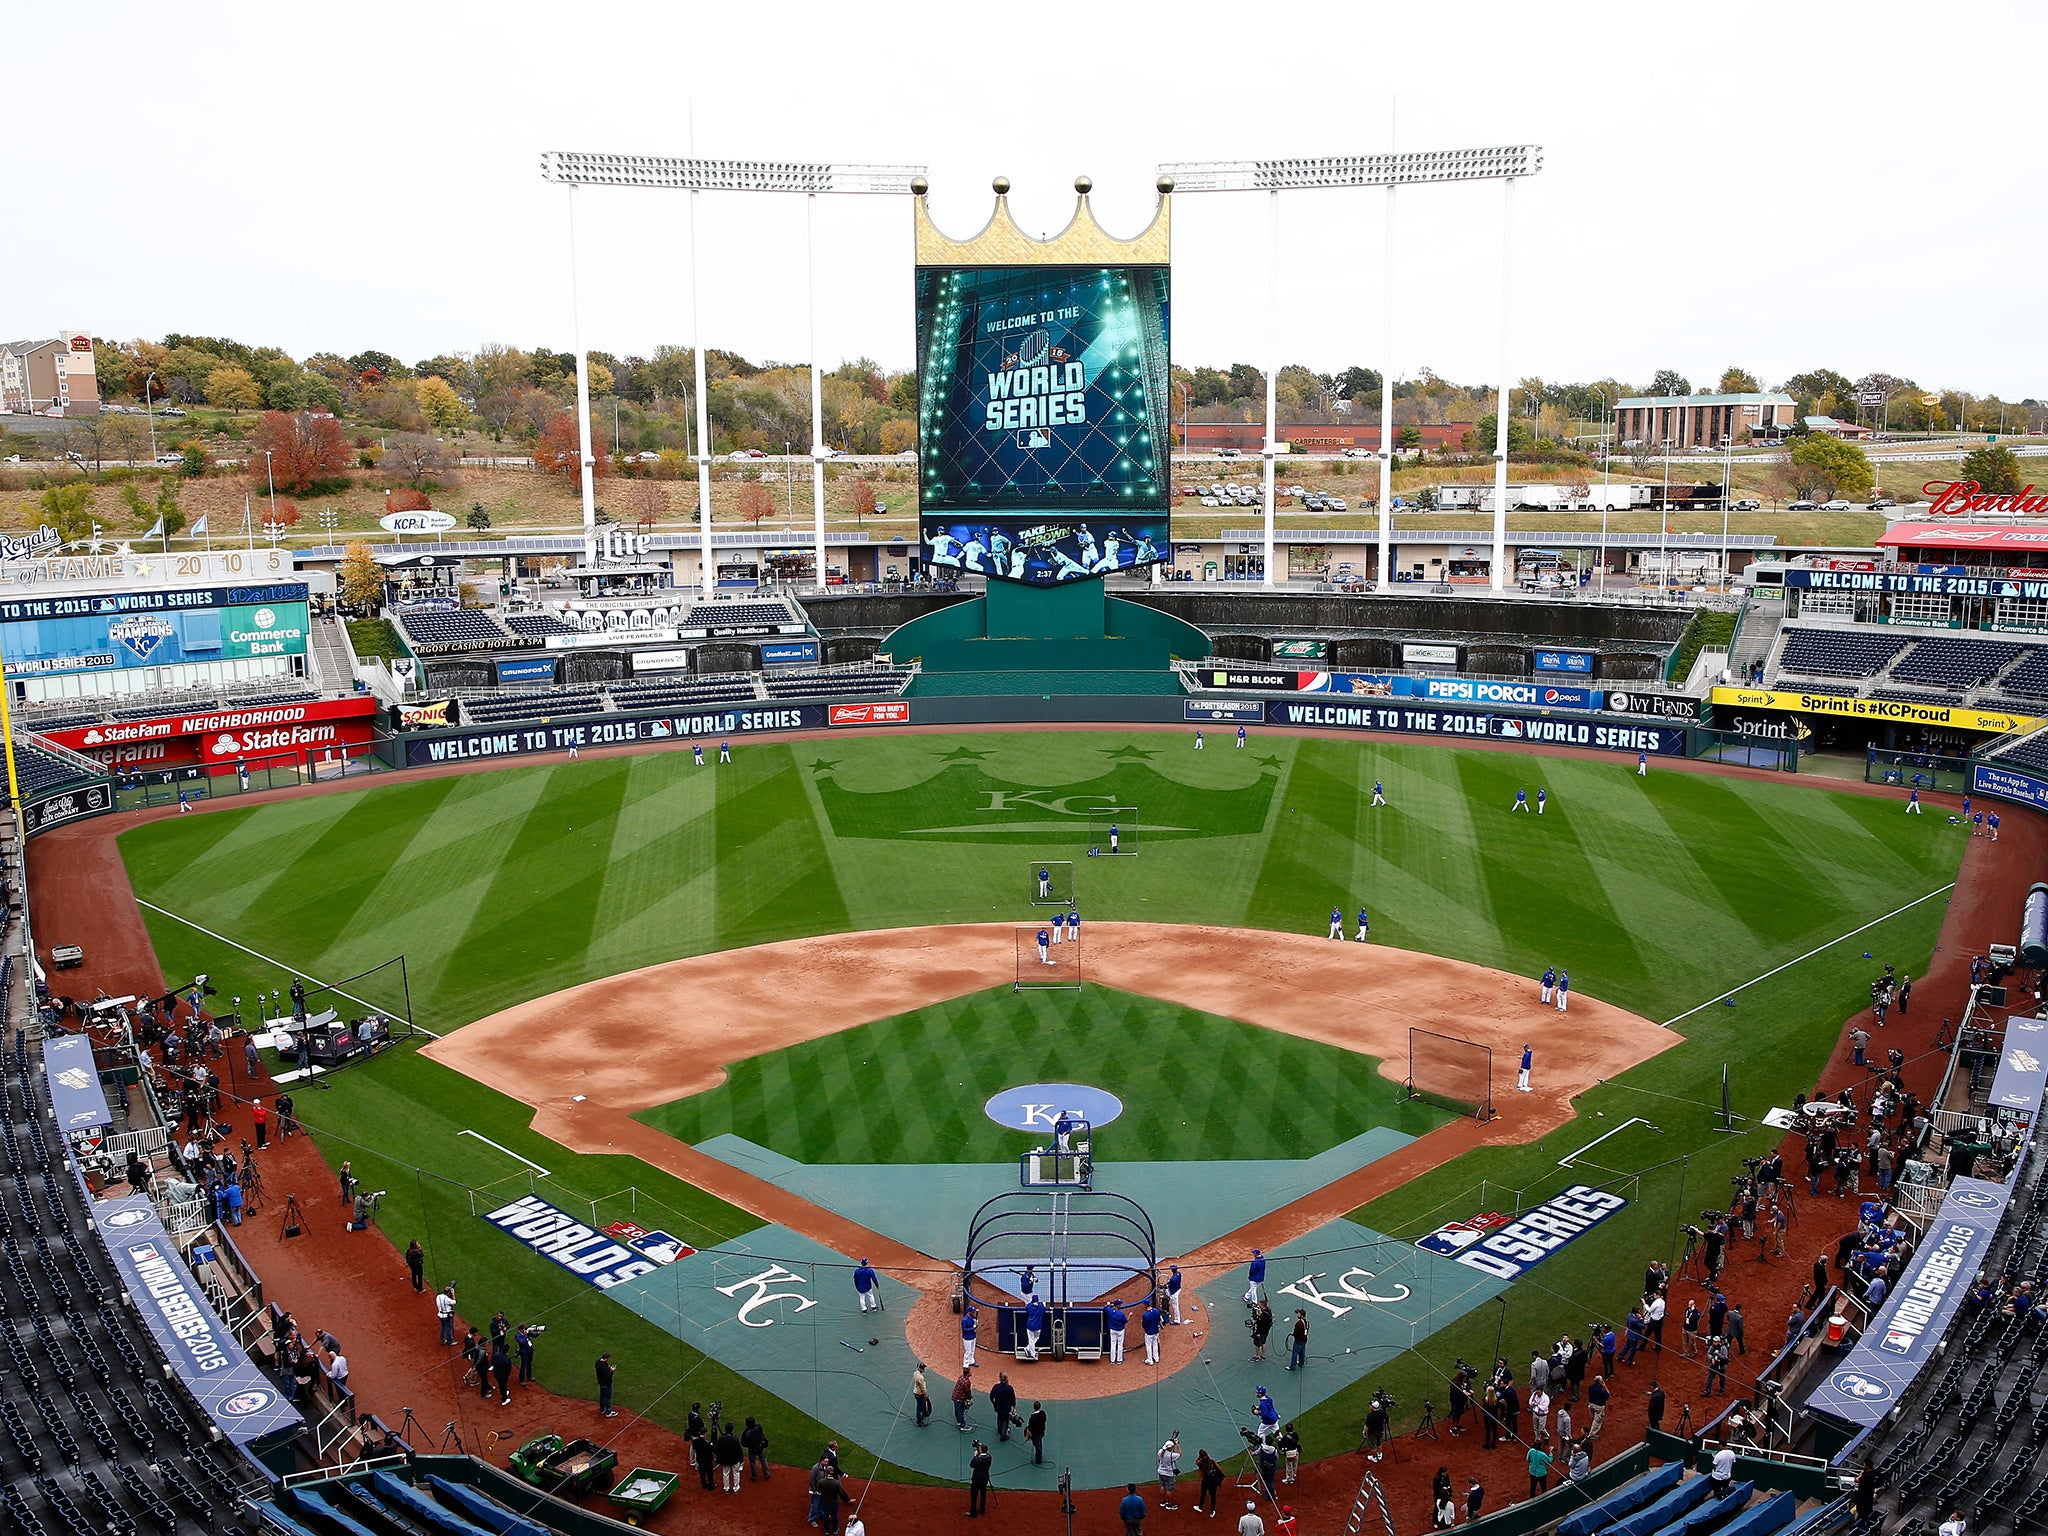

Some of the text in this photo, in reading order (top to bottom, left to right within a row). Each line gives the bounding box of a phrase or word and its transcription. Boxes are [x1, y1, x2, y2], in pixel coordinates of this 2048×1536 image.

[987, 306, 1080, 333] WELCOME TO THE
[1005, 355, 1018, 363] 20
[988, 362, 1085, 400] WORLD
[985, 392, 1086, 430] SERIES
[394, 518, 426, 530] KCP&L
[1018, 525, 1047, 540] TAKE
[0, 524, 62, 562] Royals
[600, 531, 651, 563] Lite
[19, 555, 126, 588] of FAME
[176, 551, 282, 577] 20 10 5
[1036, 570, 1052, 578] 2:37
[1809, 572, 1883, 590] WELCOME
[1888, 576, 1909, 591] TO
[1913, 577, 1943, 593] THE
[1946, 579, 1988, 595] 2015
[2, 591, 213, 618] TO THE 2015 WORLD SERIES
[600, 601, 633, 609] ORIGINAL
[608, 615, 626, 627] Lite
[632, 614, 650, 627] Lite
[654, 613, 668, 626] Lite
[1895, 618, 1949, 628] Commerce Bank
[110, 624, 174, 640] CHAMPIONS
[230, 628, 301, 643] Commerce
[713, 626, 769, 637] Quality Healthcare
[1999, 624, 2037, 634] Commerce
[134, 638, 151, 652] KC
[250, 641, 285, 654] Bank
[413, 637, 543, 654] ARGOSY CASINO HOTEL & SPA
[87, 655, 113, 666] 2015
[635, 657, 675, 665] GRUNDFOS
[502, 667, 543, 676] GRUNDFOS
[1229, 675, 1283, 685] H&R BLOCK
[1429, 681, 1536, 702] PEPSI PORCH
[1559, 693, 1581, 703] pepsi
[1737, 693, 1763, 706] Sprint
[1200, 701, 1240, 710] POSTSEASON
[1801, 696, 1950, 722] Sprint is #KCProud
[182, 707, 305, 732] NEIGHBORHOOD
[403, 708, 446, 723] SONIC
[1977, 717, 2005, 729] Sprint
[428, 710, 801, 761] WELCOME TO THE 2015 WORLD SERIES
[1288, 705, 1660, 750] WELCOME TO THE 2015 WORLD SERIES
[1733, 716, 1787, 739] Sprint
[1921, 727, 1965, 745] Sprint
[1978, 780, 1992, 789] Live
[1992, 783, 2012, 794] Royals
[1988, 772, 1999, 782] The
[2007, 777, 2020, 788] App
[975, 790, 1119, 817] KC
[1020, 1104, 1086, 1131] KC
[2000, 1109, 2030, 1121] MLB
[70, 1127, 100, 1141] MLB
[1480, 1185, 1627, 1263] SERIES
[484, 1196, 633, 1275] WORLD
[1939, 1224, 1976, 1256] 2015
[714, 1262, 819, 1329] KC
[1276, 1266, 1414, 1320] KC
[184, 1334, 229, 1373] 2015
